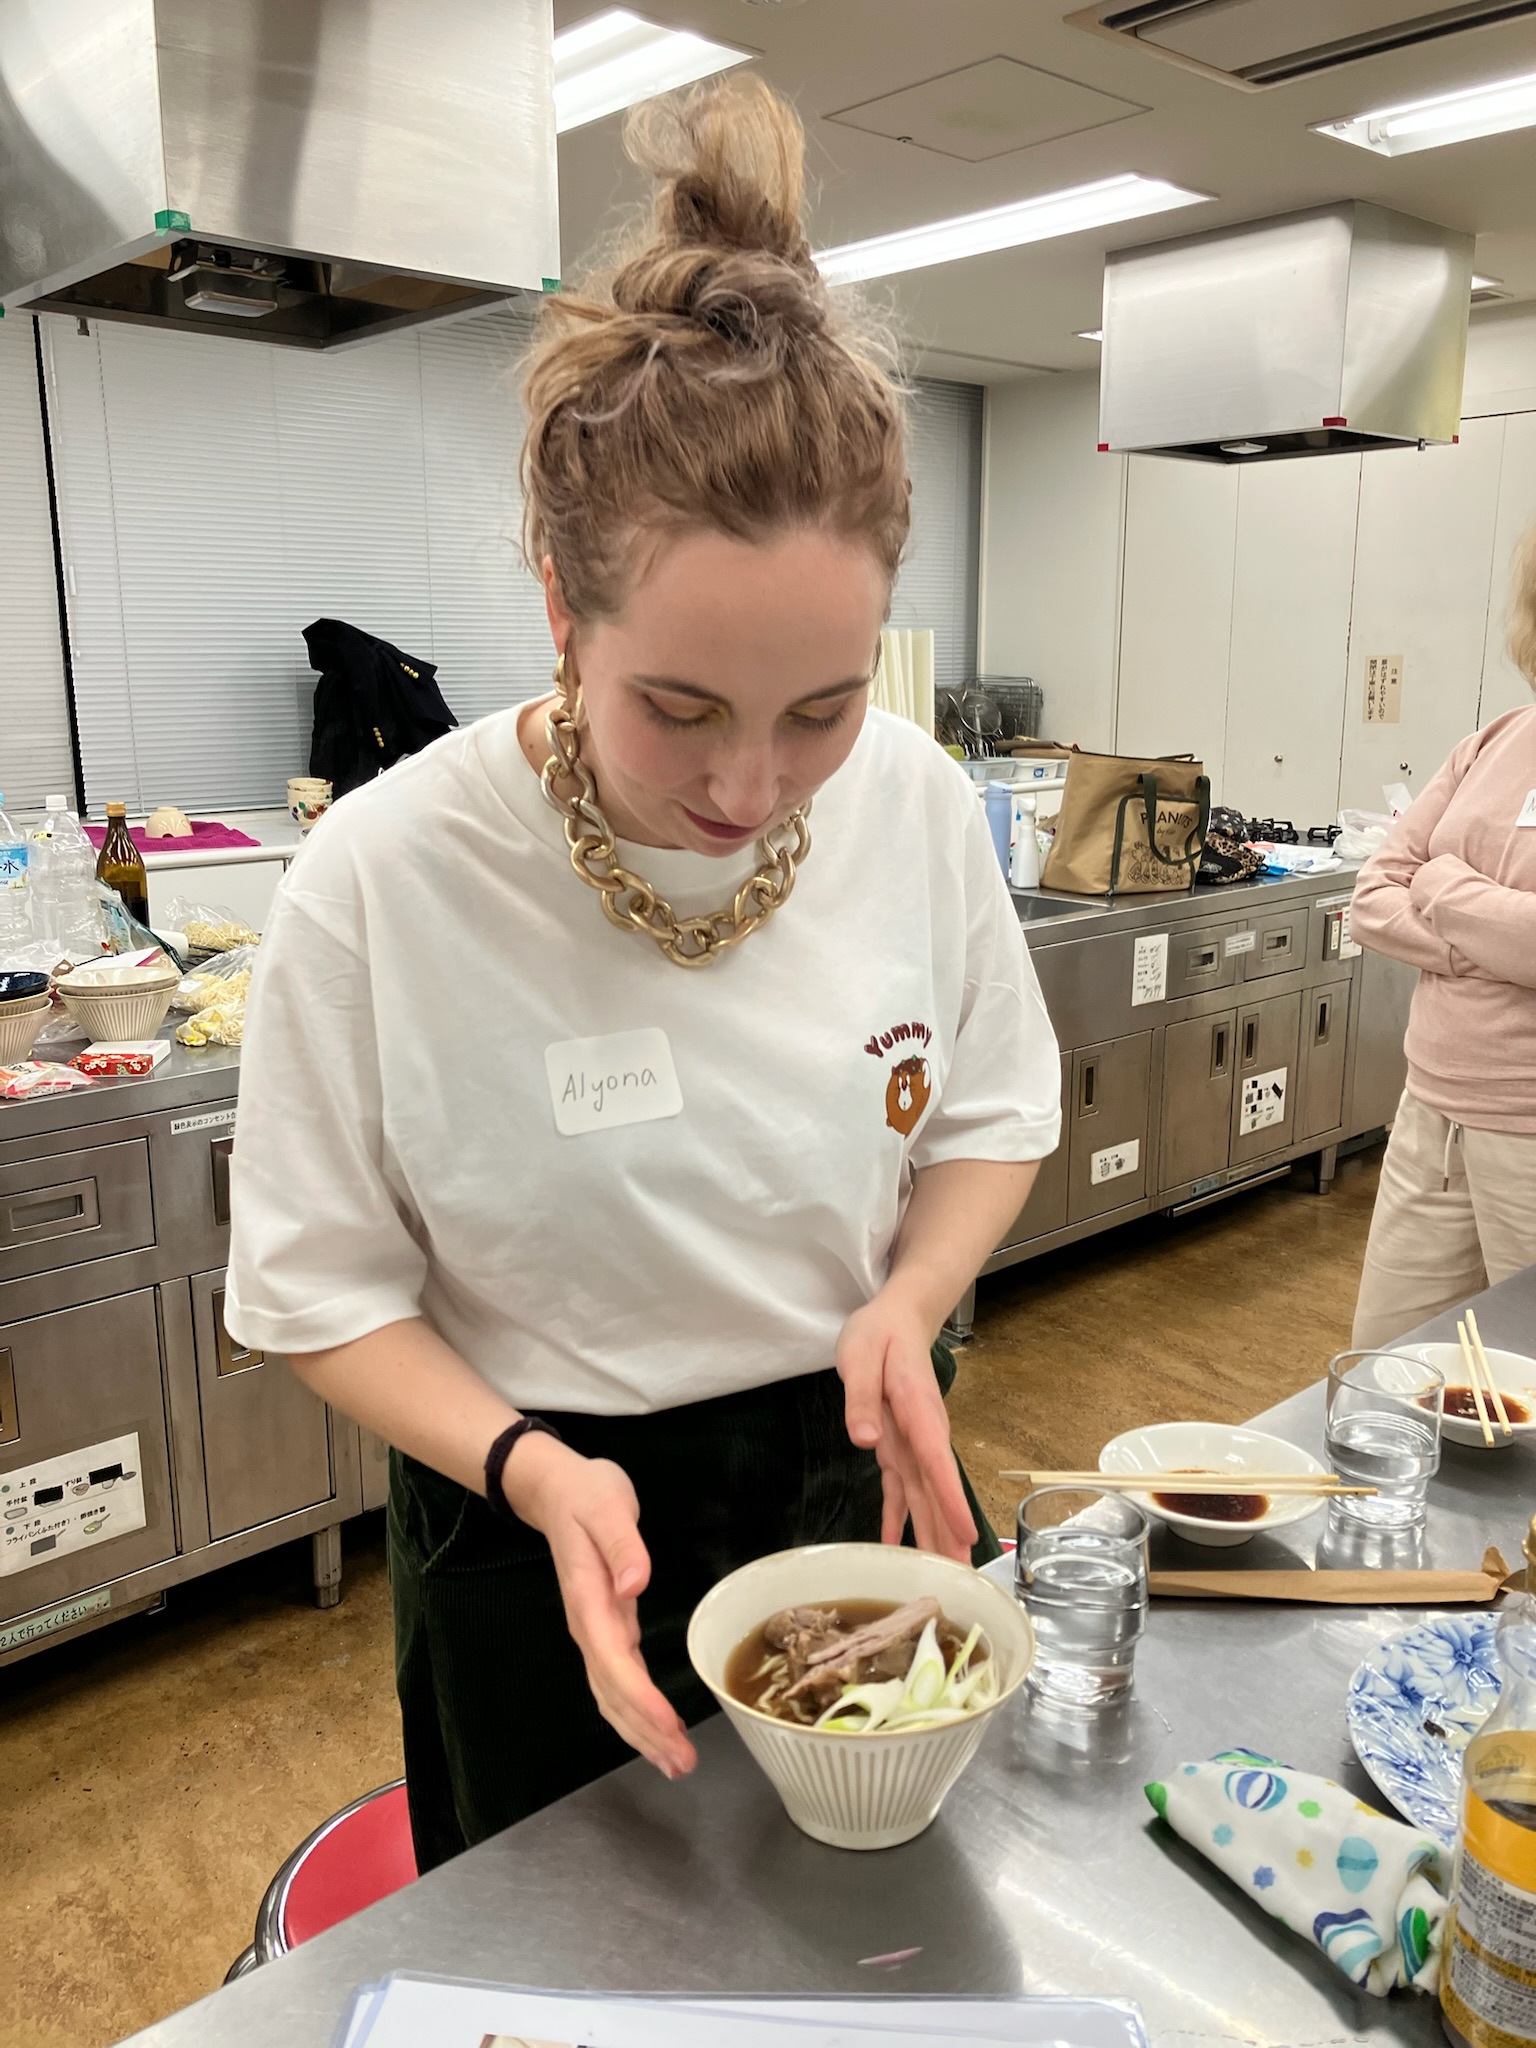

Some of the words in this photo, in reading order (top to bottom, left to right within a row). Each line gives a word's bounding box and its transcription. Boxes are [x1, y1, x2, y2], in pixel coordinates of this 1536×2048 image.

[1140, 811, 1192, 828] PANUTS
[864, 1021, 932, 1058] Yummy
[562, 1068, 657, 1112] Alyona
